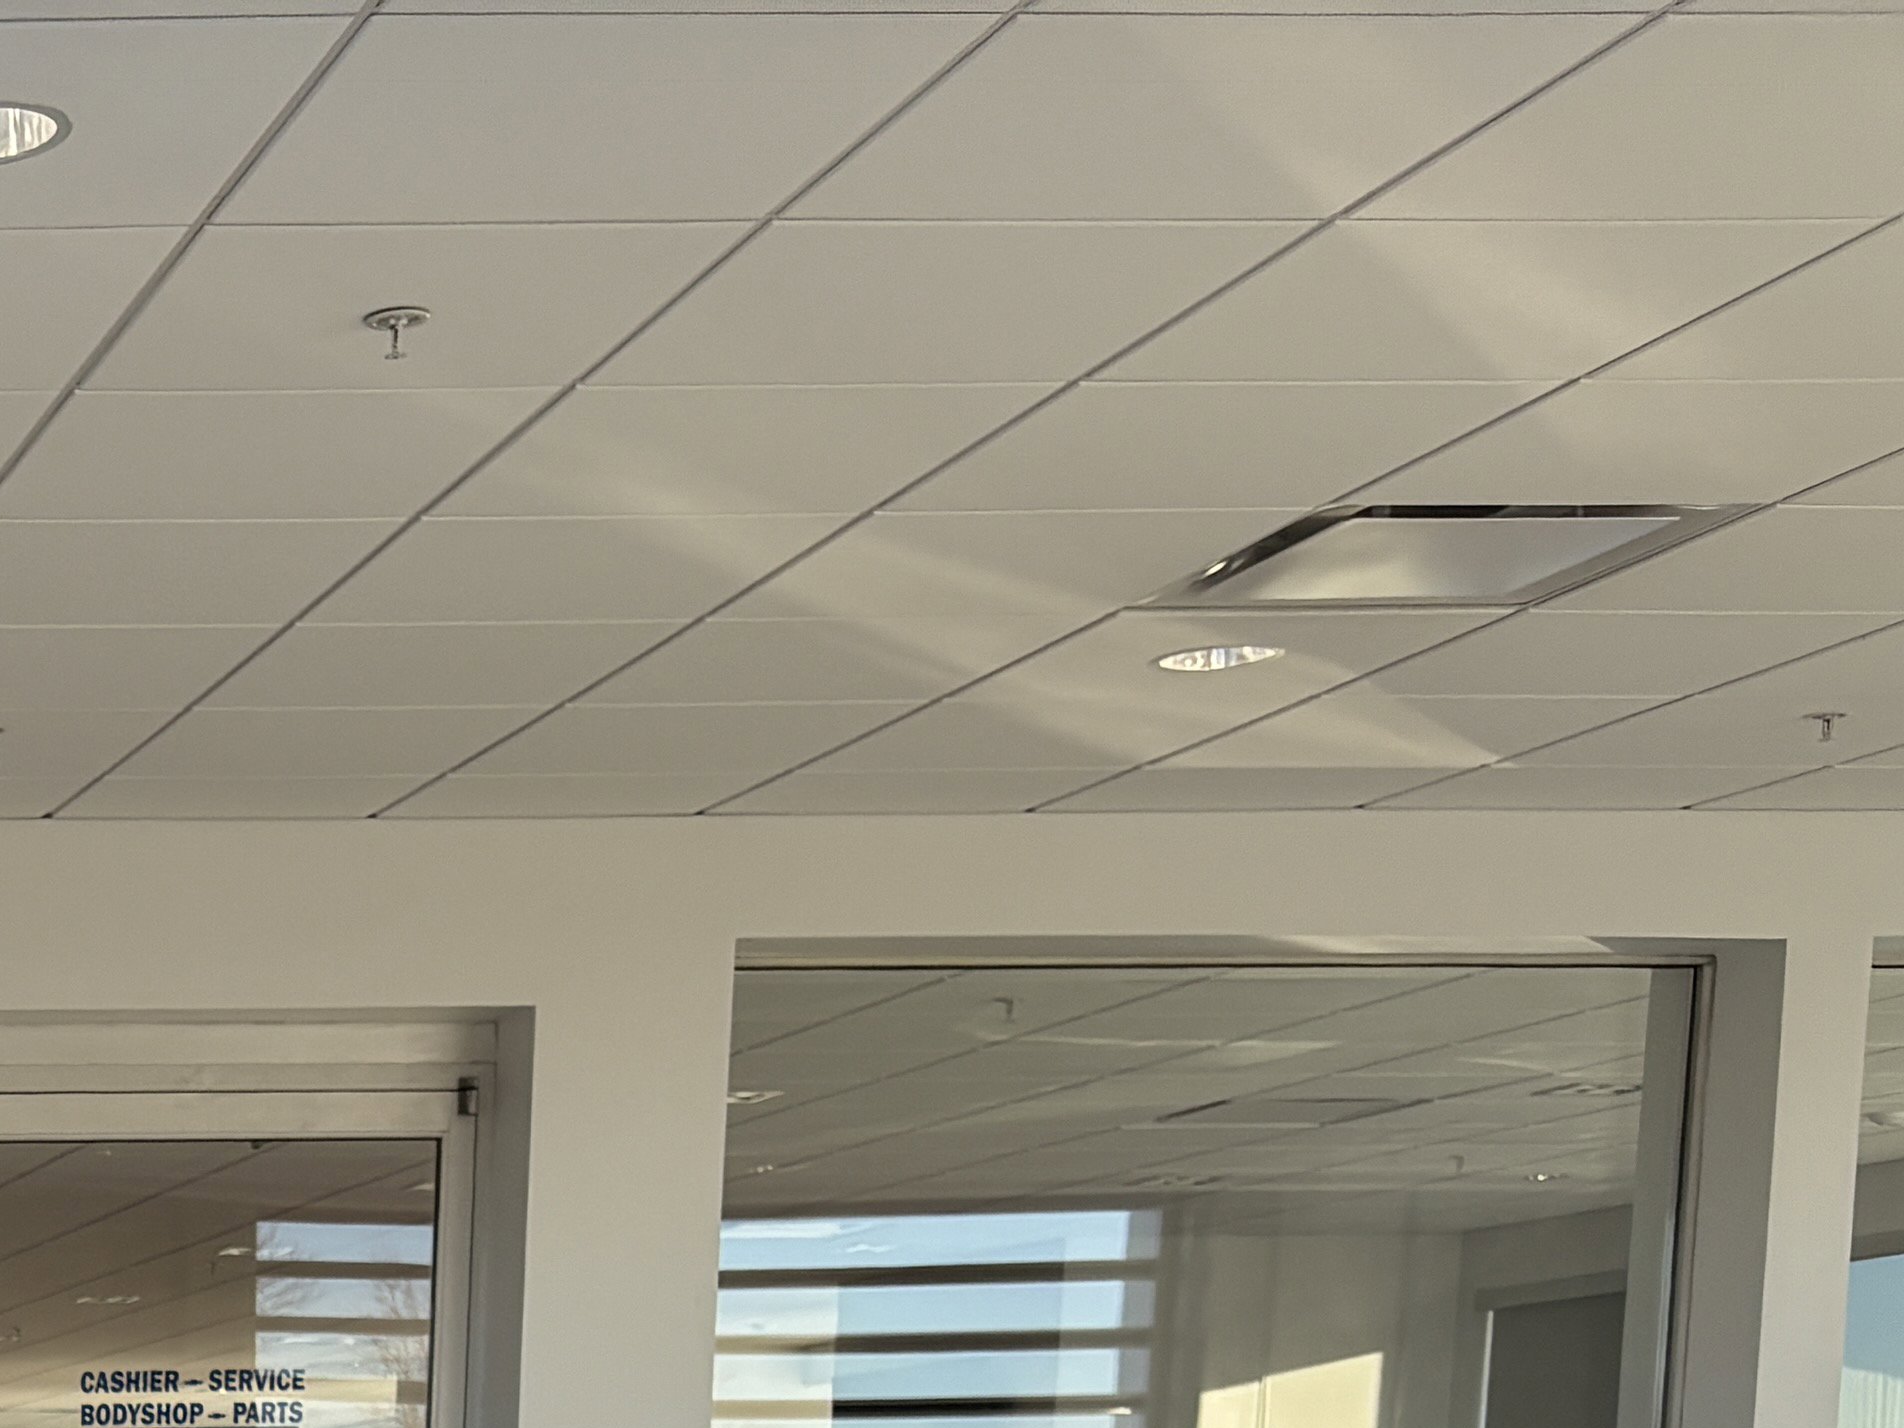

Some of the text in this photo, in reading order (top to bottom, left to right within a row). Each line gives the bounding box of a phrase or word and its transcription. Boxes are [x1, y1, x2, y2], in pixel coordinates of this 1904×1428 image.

[80, 1369, 306, 1394] CASHIER SERVICE
[80, 1401, 303, 1426] BODYSHOP PARTS
